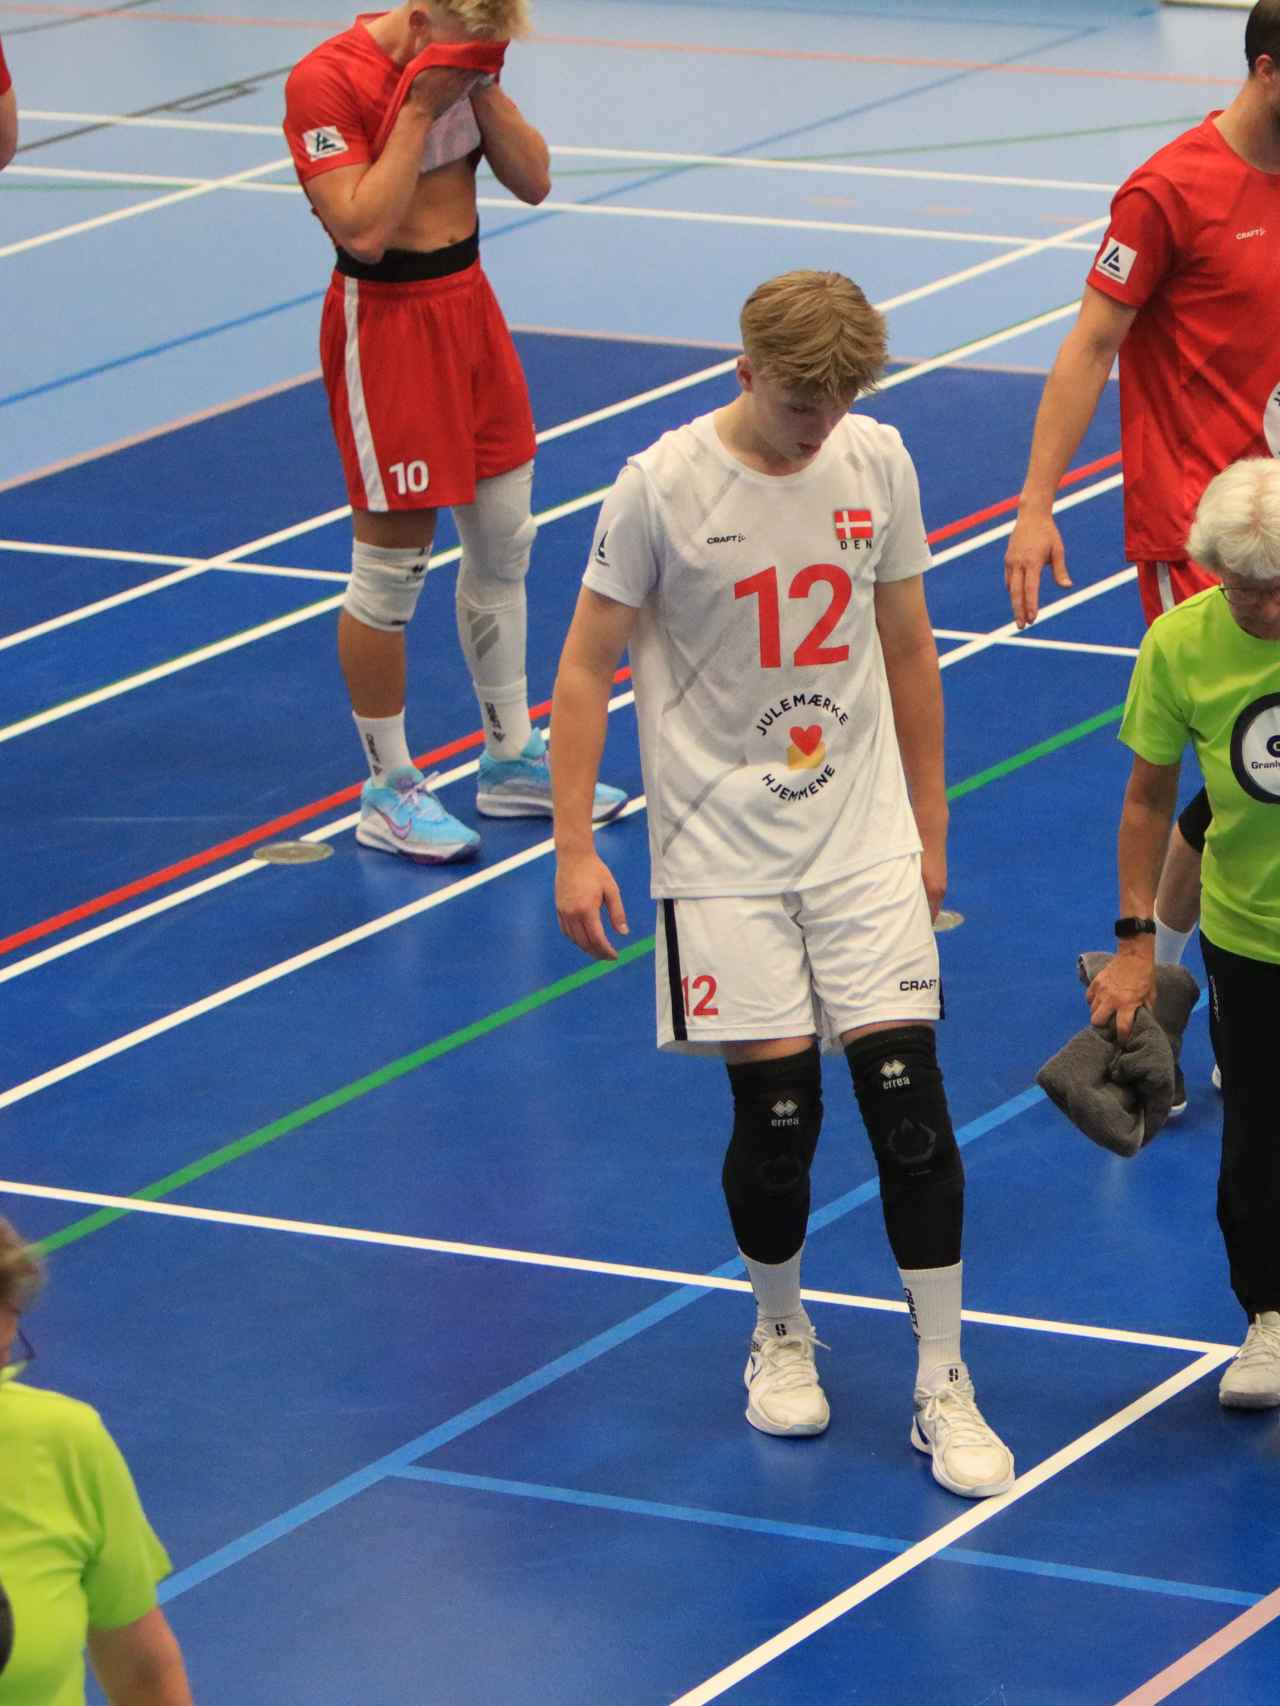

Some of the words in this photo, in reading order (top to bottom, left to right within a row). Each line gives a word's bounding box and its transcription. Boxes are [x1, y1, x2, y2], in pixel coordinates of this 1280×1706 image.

[1235, 228, 1261, 240] CRAFT
[388, 460, 429, 495] 10
[706, 535, 738, 545] CRAFT
[734, 563, 852, 668] 12
[756, 694, 848, 736] JULEMÆRKE
[762, 764, 835, 801] HJEMMENE
